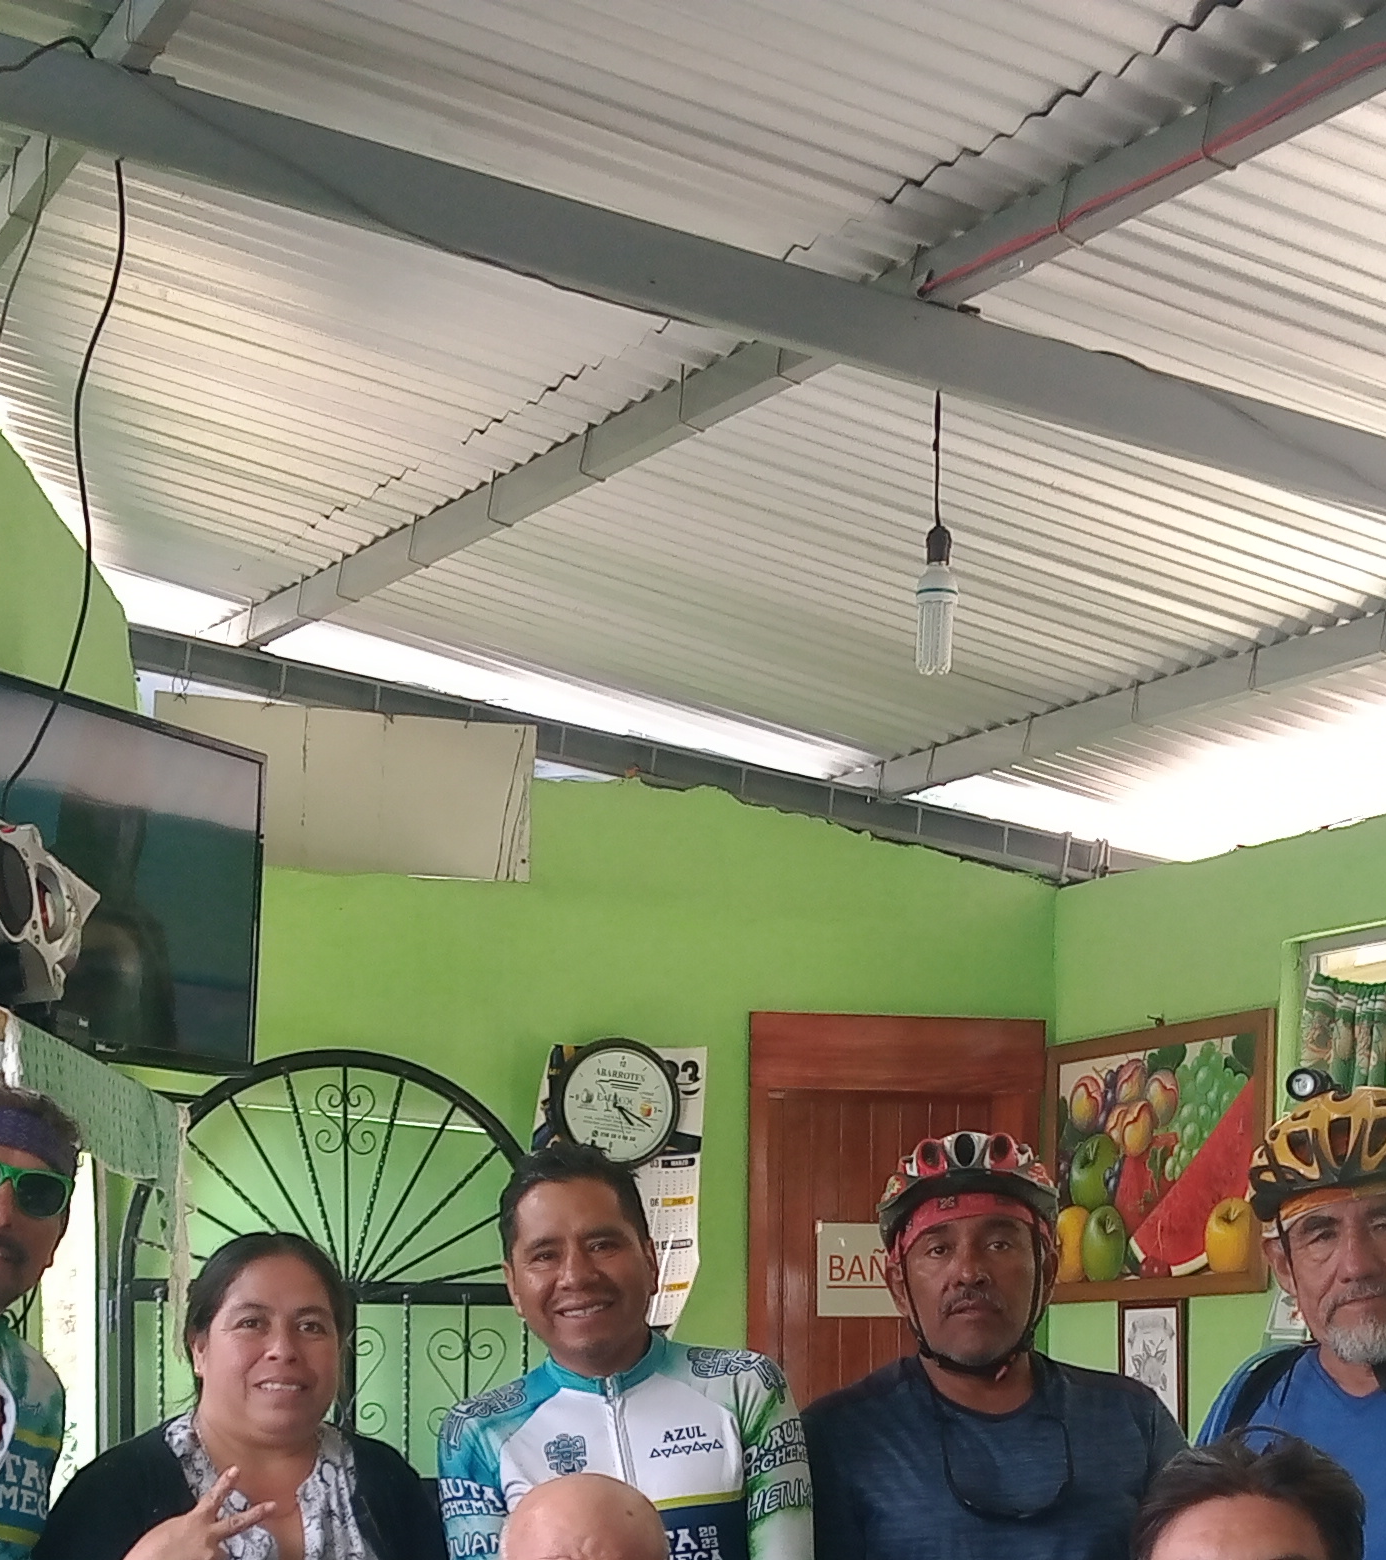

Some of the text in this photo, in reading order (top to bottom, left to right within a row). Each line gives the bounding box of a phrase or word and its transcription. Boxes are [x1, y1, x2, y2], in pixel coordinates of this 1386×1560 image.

[595, 1067, 646, 1083] ABARROTES
[829, 1248, 889, 1282] BAÑ
[662, 1425, 708, 1443] AZUL
[769, 1419, 806, 1451] RUT
[746, 1479, 813, 1521] HETUM
[698, 1525, 718, 1538] 20
[700, 1536, 720, 1550] 23
